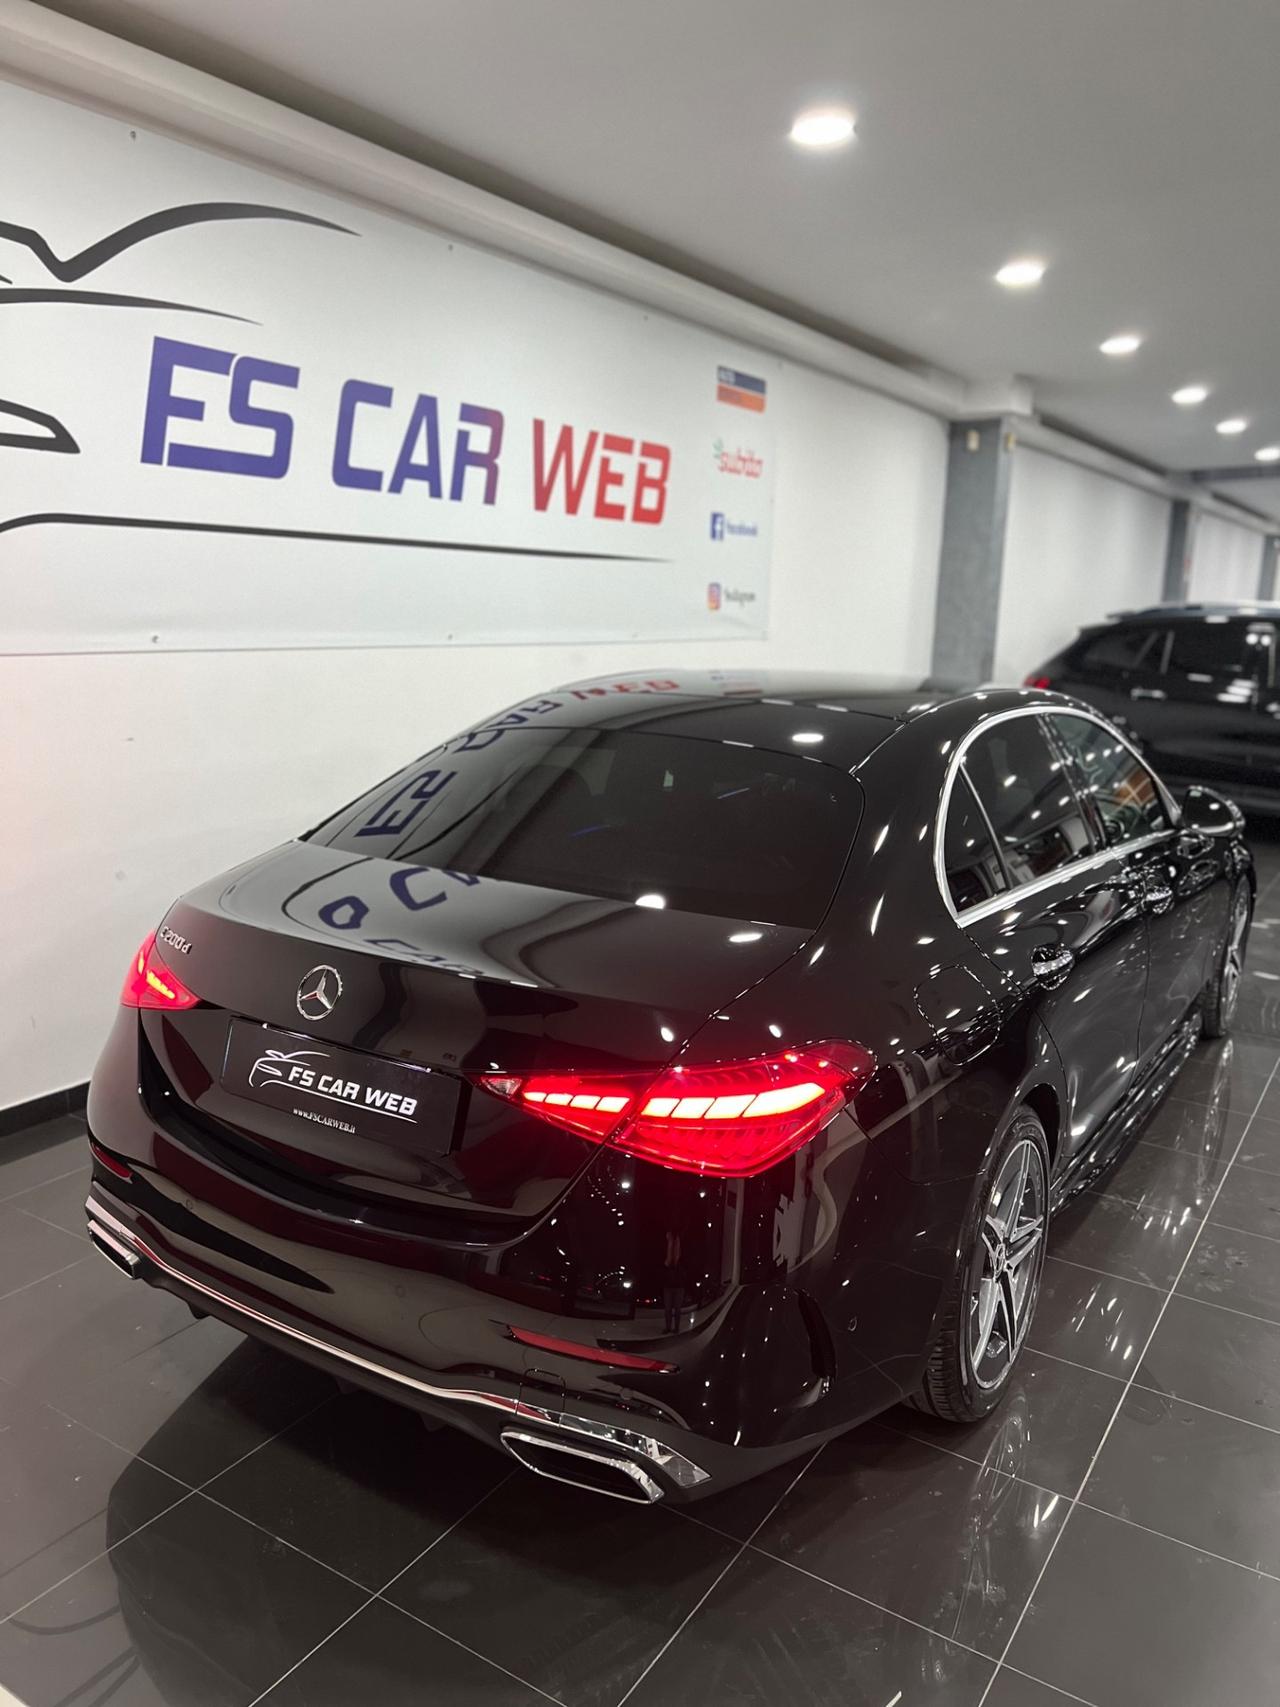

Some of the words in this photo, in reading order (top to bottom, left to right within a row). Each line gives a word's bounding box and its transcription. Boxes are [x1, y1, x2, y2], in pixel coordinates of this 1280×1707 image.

[332, 379, 504, 506] CAR
[532, 418, 671, 525] WEB
[288, 1066, 316, 1087] FS
[317, 1075, 360, 1100] CAR
[364, 1087, 418, 1116] WEB
